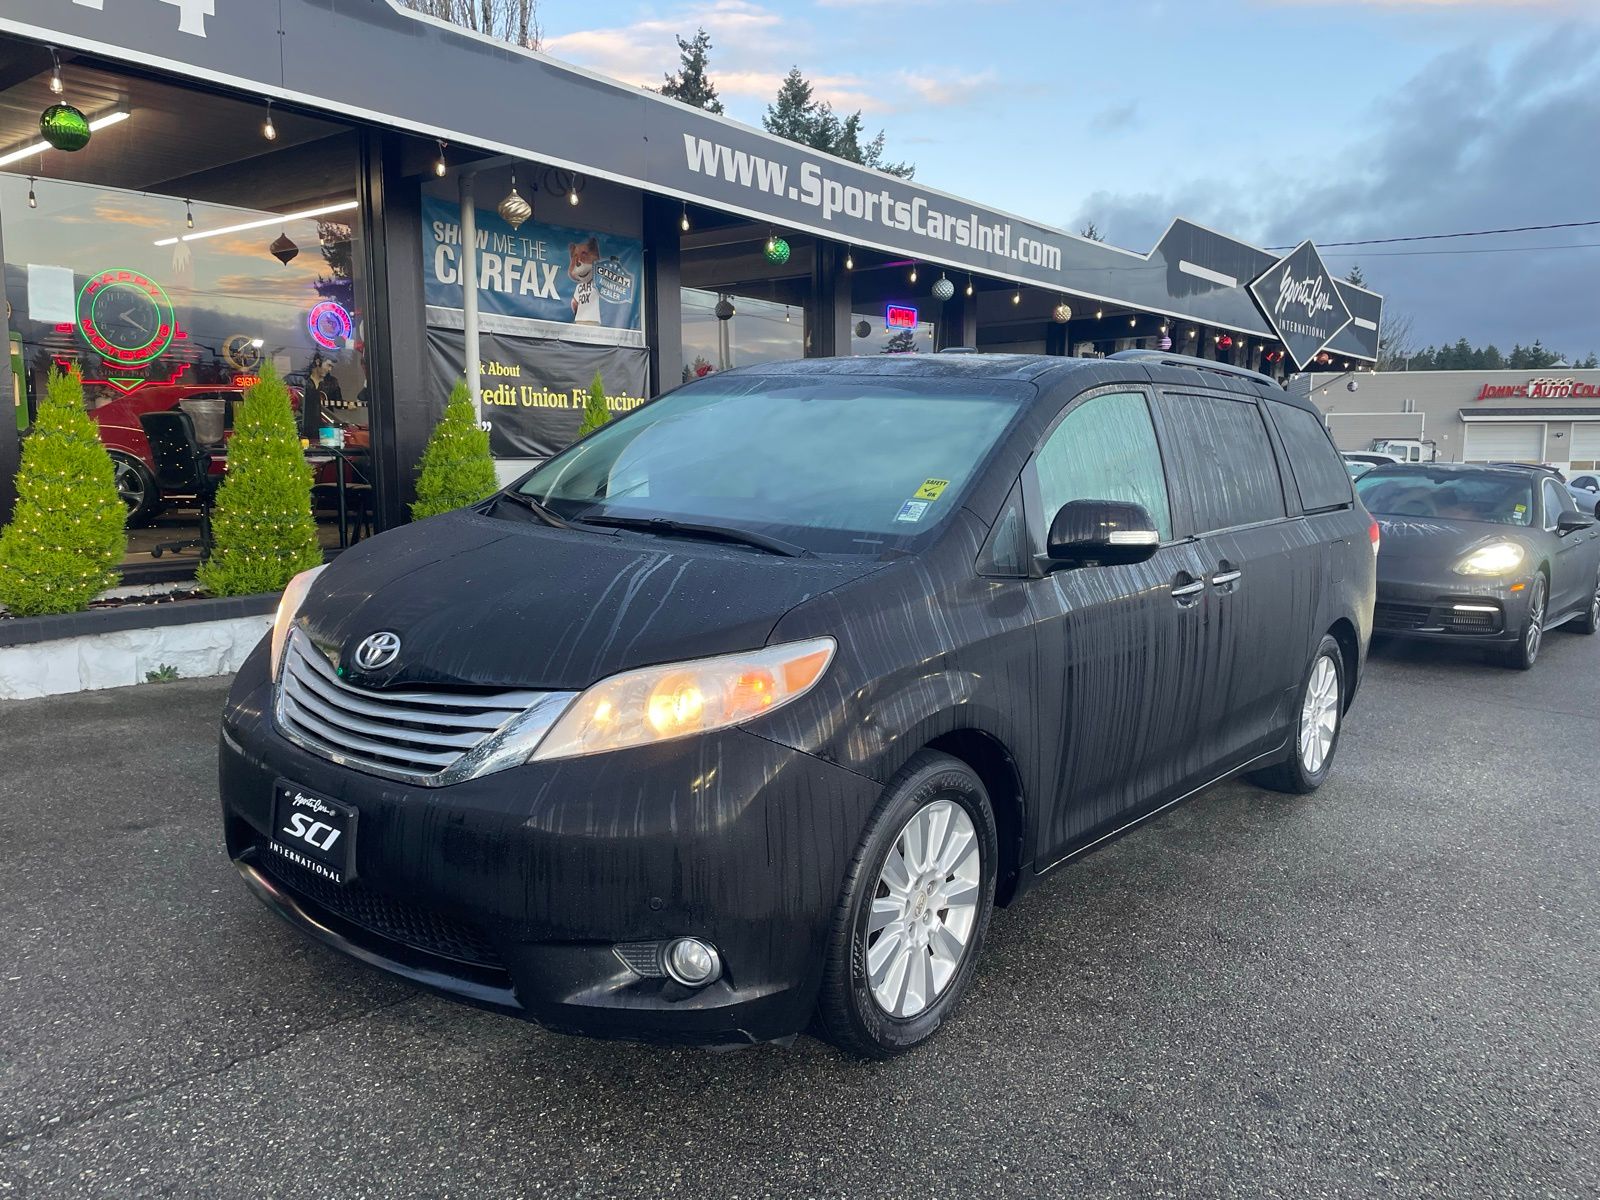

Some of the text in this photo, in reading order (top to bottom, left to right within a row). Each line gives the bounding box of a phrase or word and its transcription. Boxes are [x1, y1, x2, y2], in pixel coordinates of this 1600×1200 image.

[683, 133, 1061, 271] www.SportsCarsIntl.com
[433, 221, 547, 260] SHW ME THE
[87, 271, 160, 296] HAPPY
[578, 281, 592, 293] CAR
[600, 278, 626, 295] ADVANTAGE
[600, 287, 620, 300] DEALER
[1275, 265, 1315, 314] Sports
[579, 293, 590, 304] FOX
[82, 319, 170, 360] MOTORING
[1279, 318, 1326, 339] INTERNATIONAL
[488, 362, 520, 377] About
[480, 384, 645, 411] edit Union Fincin
[1477, 384, 1527, 400] JOHN'S
[1533, 384, 1569, 398] AUTO
[292, 792, 316, 806] Sports
[283, 812, 341, 851] SCI
[270, 841, 341, 883] INTERNATIONAL
